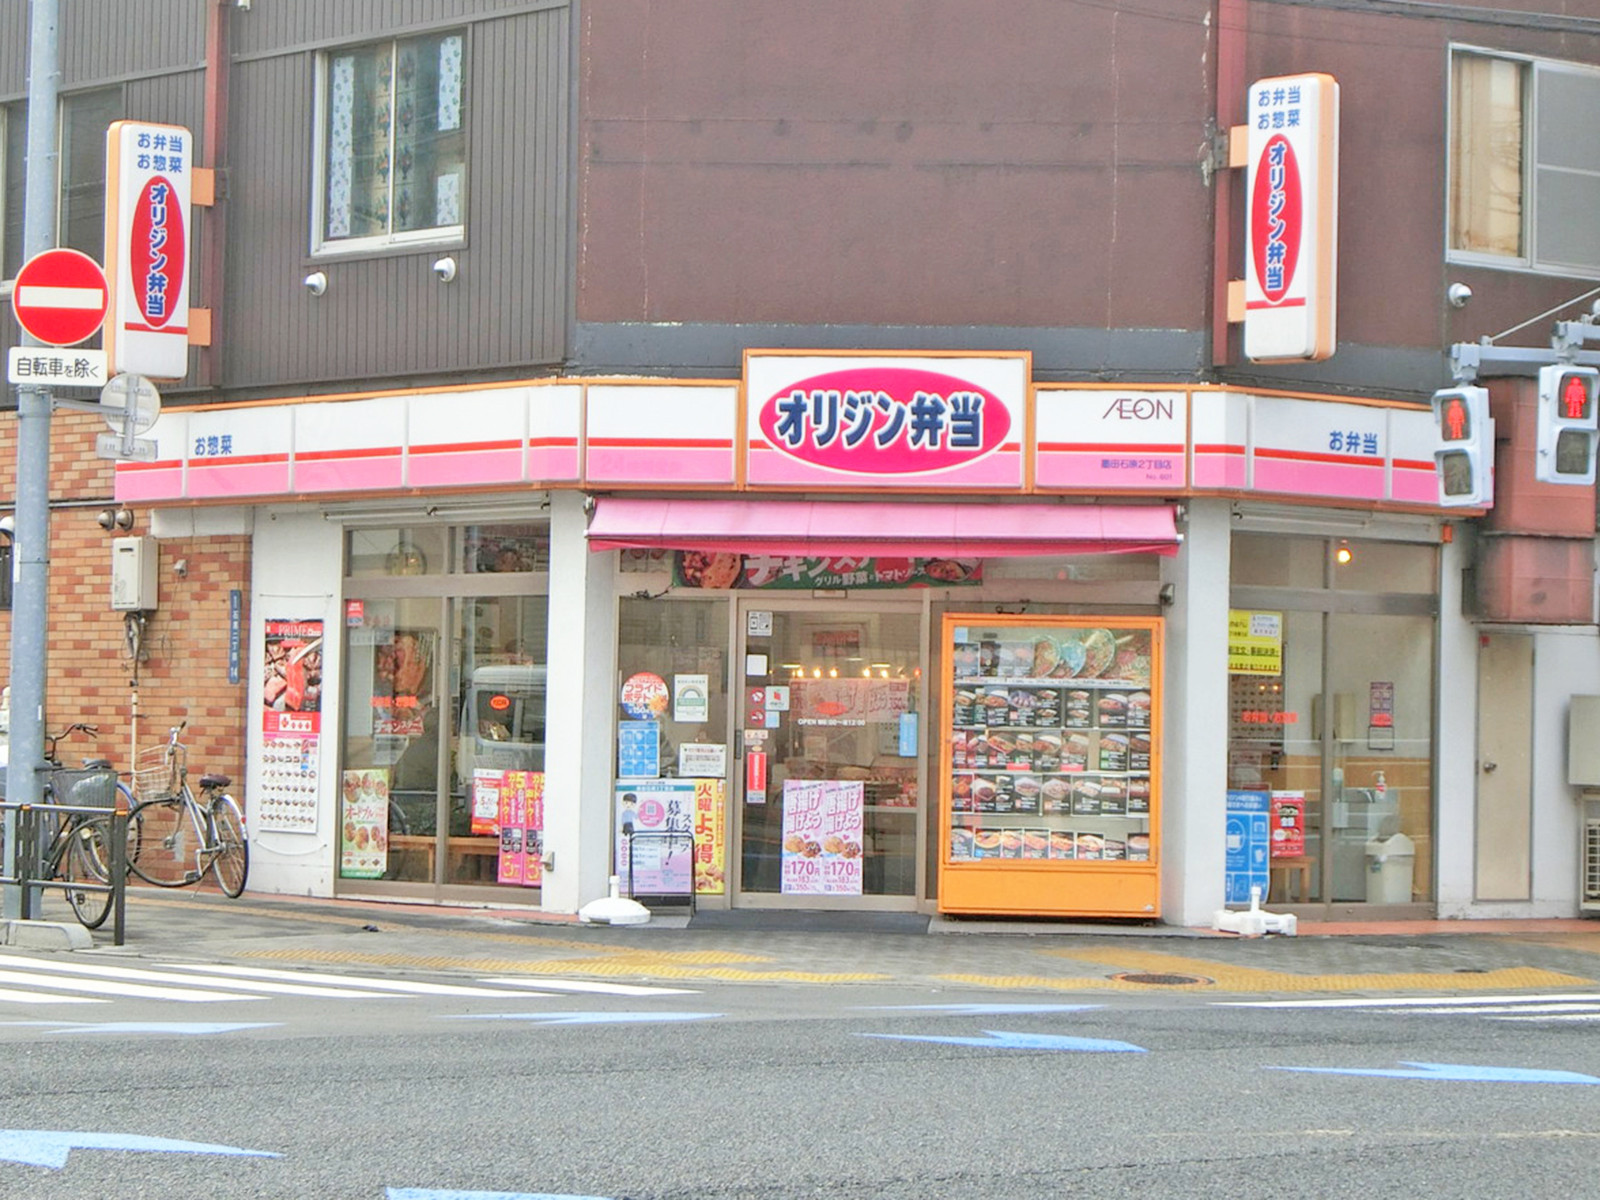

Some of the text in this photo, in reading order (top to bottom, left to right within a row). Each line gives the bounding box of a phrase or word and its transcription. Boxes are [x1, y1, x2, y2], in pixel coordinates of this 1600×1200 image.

[1258, 85, 1300, 107] お弁当
[1258, 109, 1300, 130] お惣菜
[137, 133, 183, 153] お弁当
[137, 153, 183, 173] お惣菜
[1267, 143, 1286, 290] オリジン弁当
[148, 184, 168, 317] オリジン弁当
[17, 357, 98, 378] 自転車を除く
[775, 390, 985, 449] オリジン弁当
[195, 435, 232, 456] お惣菜
[1329, 430, 1378, 455] お弁当
